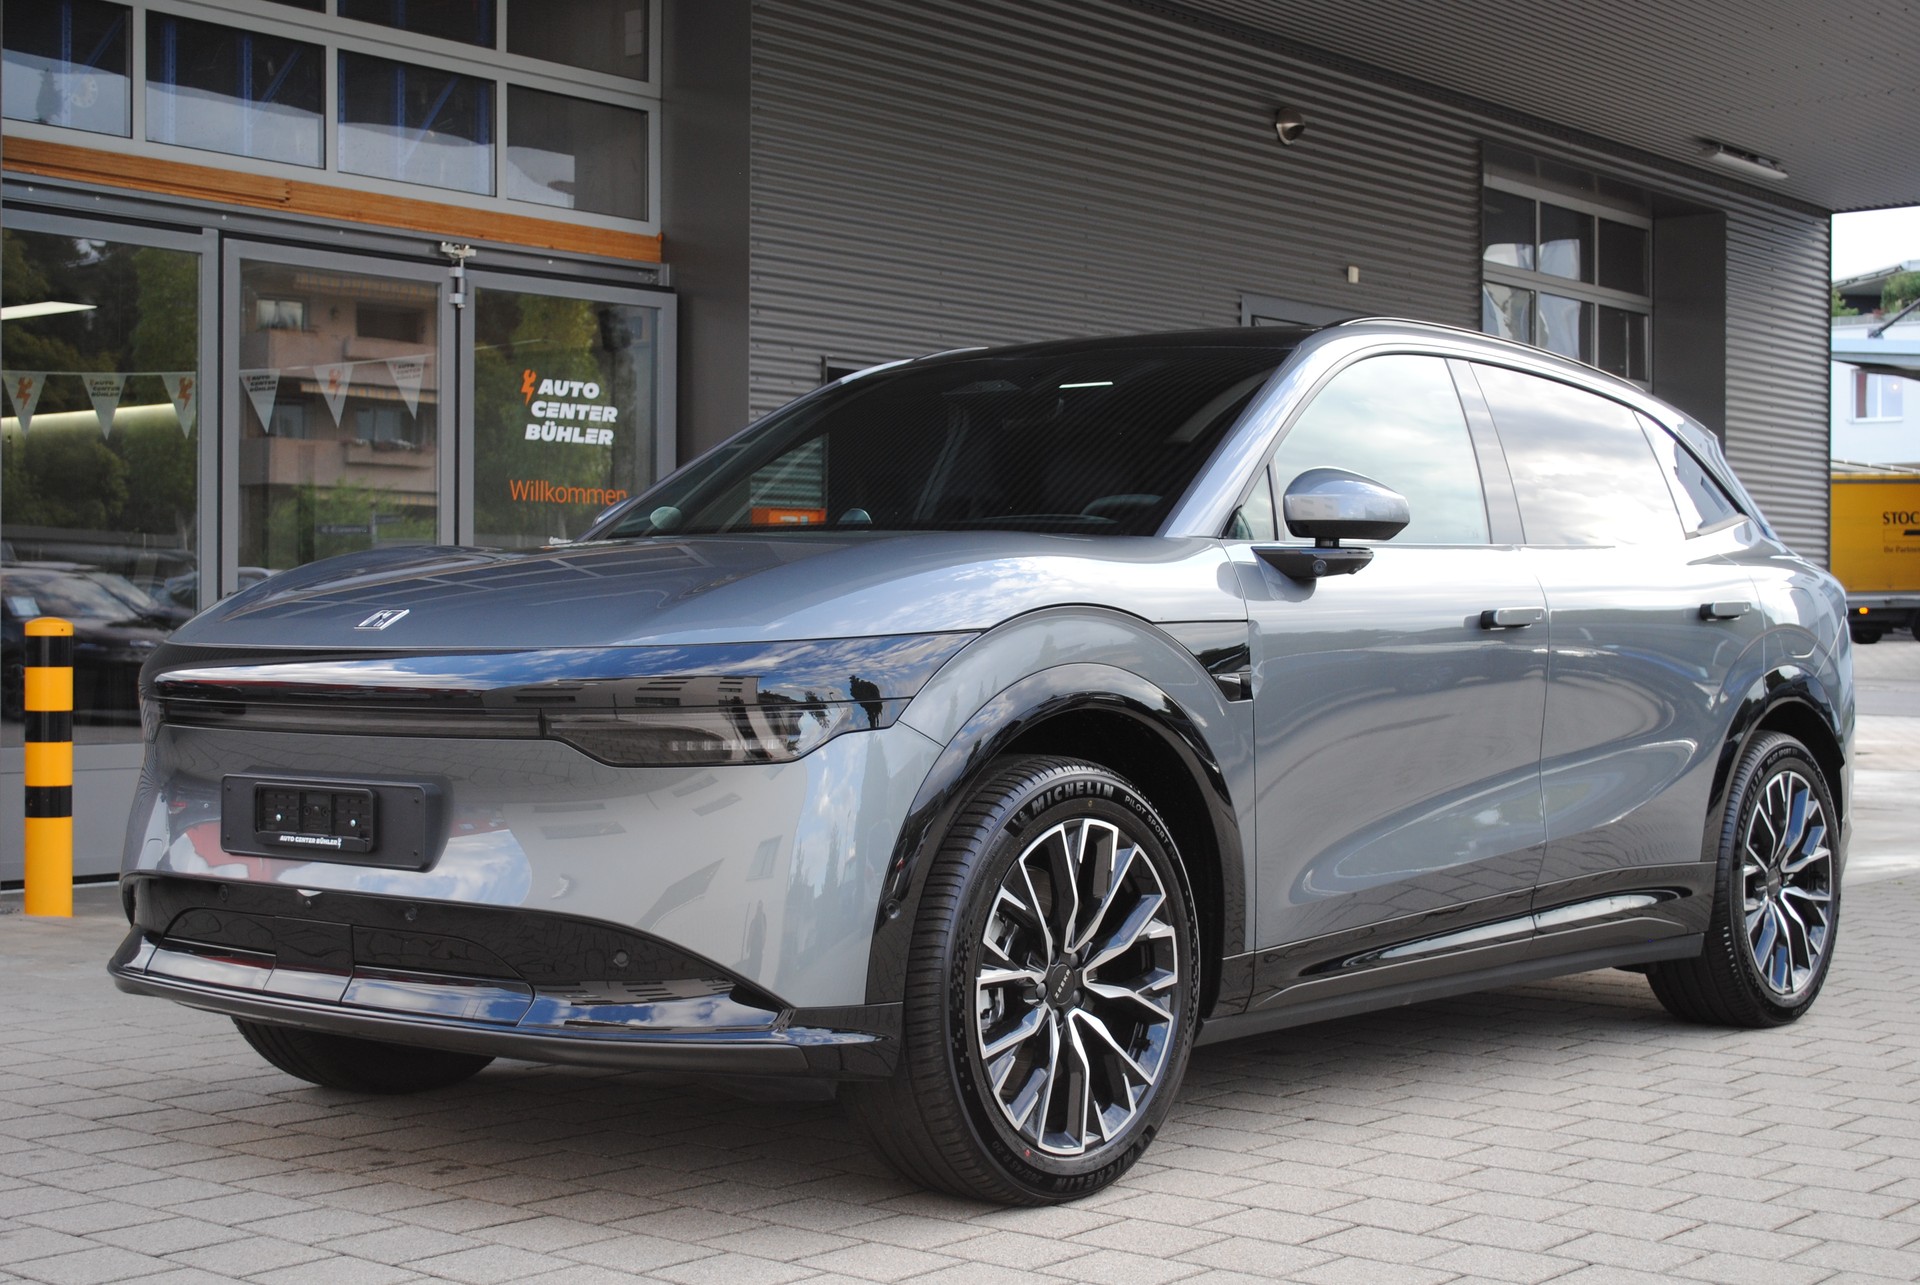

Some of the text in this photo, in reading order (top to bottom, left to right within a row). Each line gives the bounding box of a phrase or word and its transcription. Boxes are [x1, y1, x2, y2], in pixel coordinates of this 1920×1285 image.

[537, 379, 600, 399] AUTO
[531, 400, 619, 422] CENTER
[524, 420, 614, 445] BÜHLER
[1032, 781, 1115, 816] MICHELIN
[1124, 795, 1147, 814] PILOT
[1147, 814, 1169, 844] SPORT
[295, 836, 316, 844] CENTER
[316, 837, 338, 845] BÜHLER
[1054, 968, 1071, 999] ZEEKR
